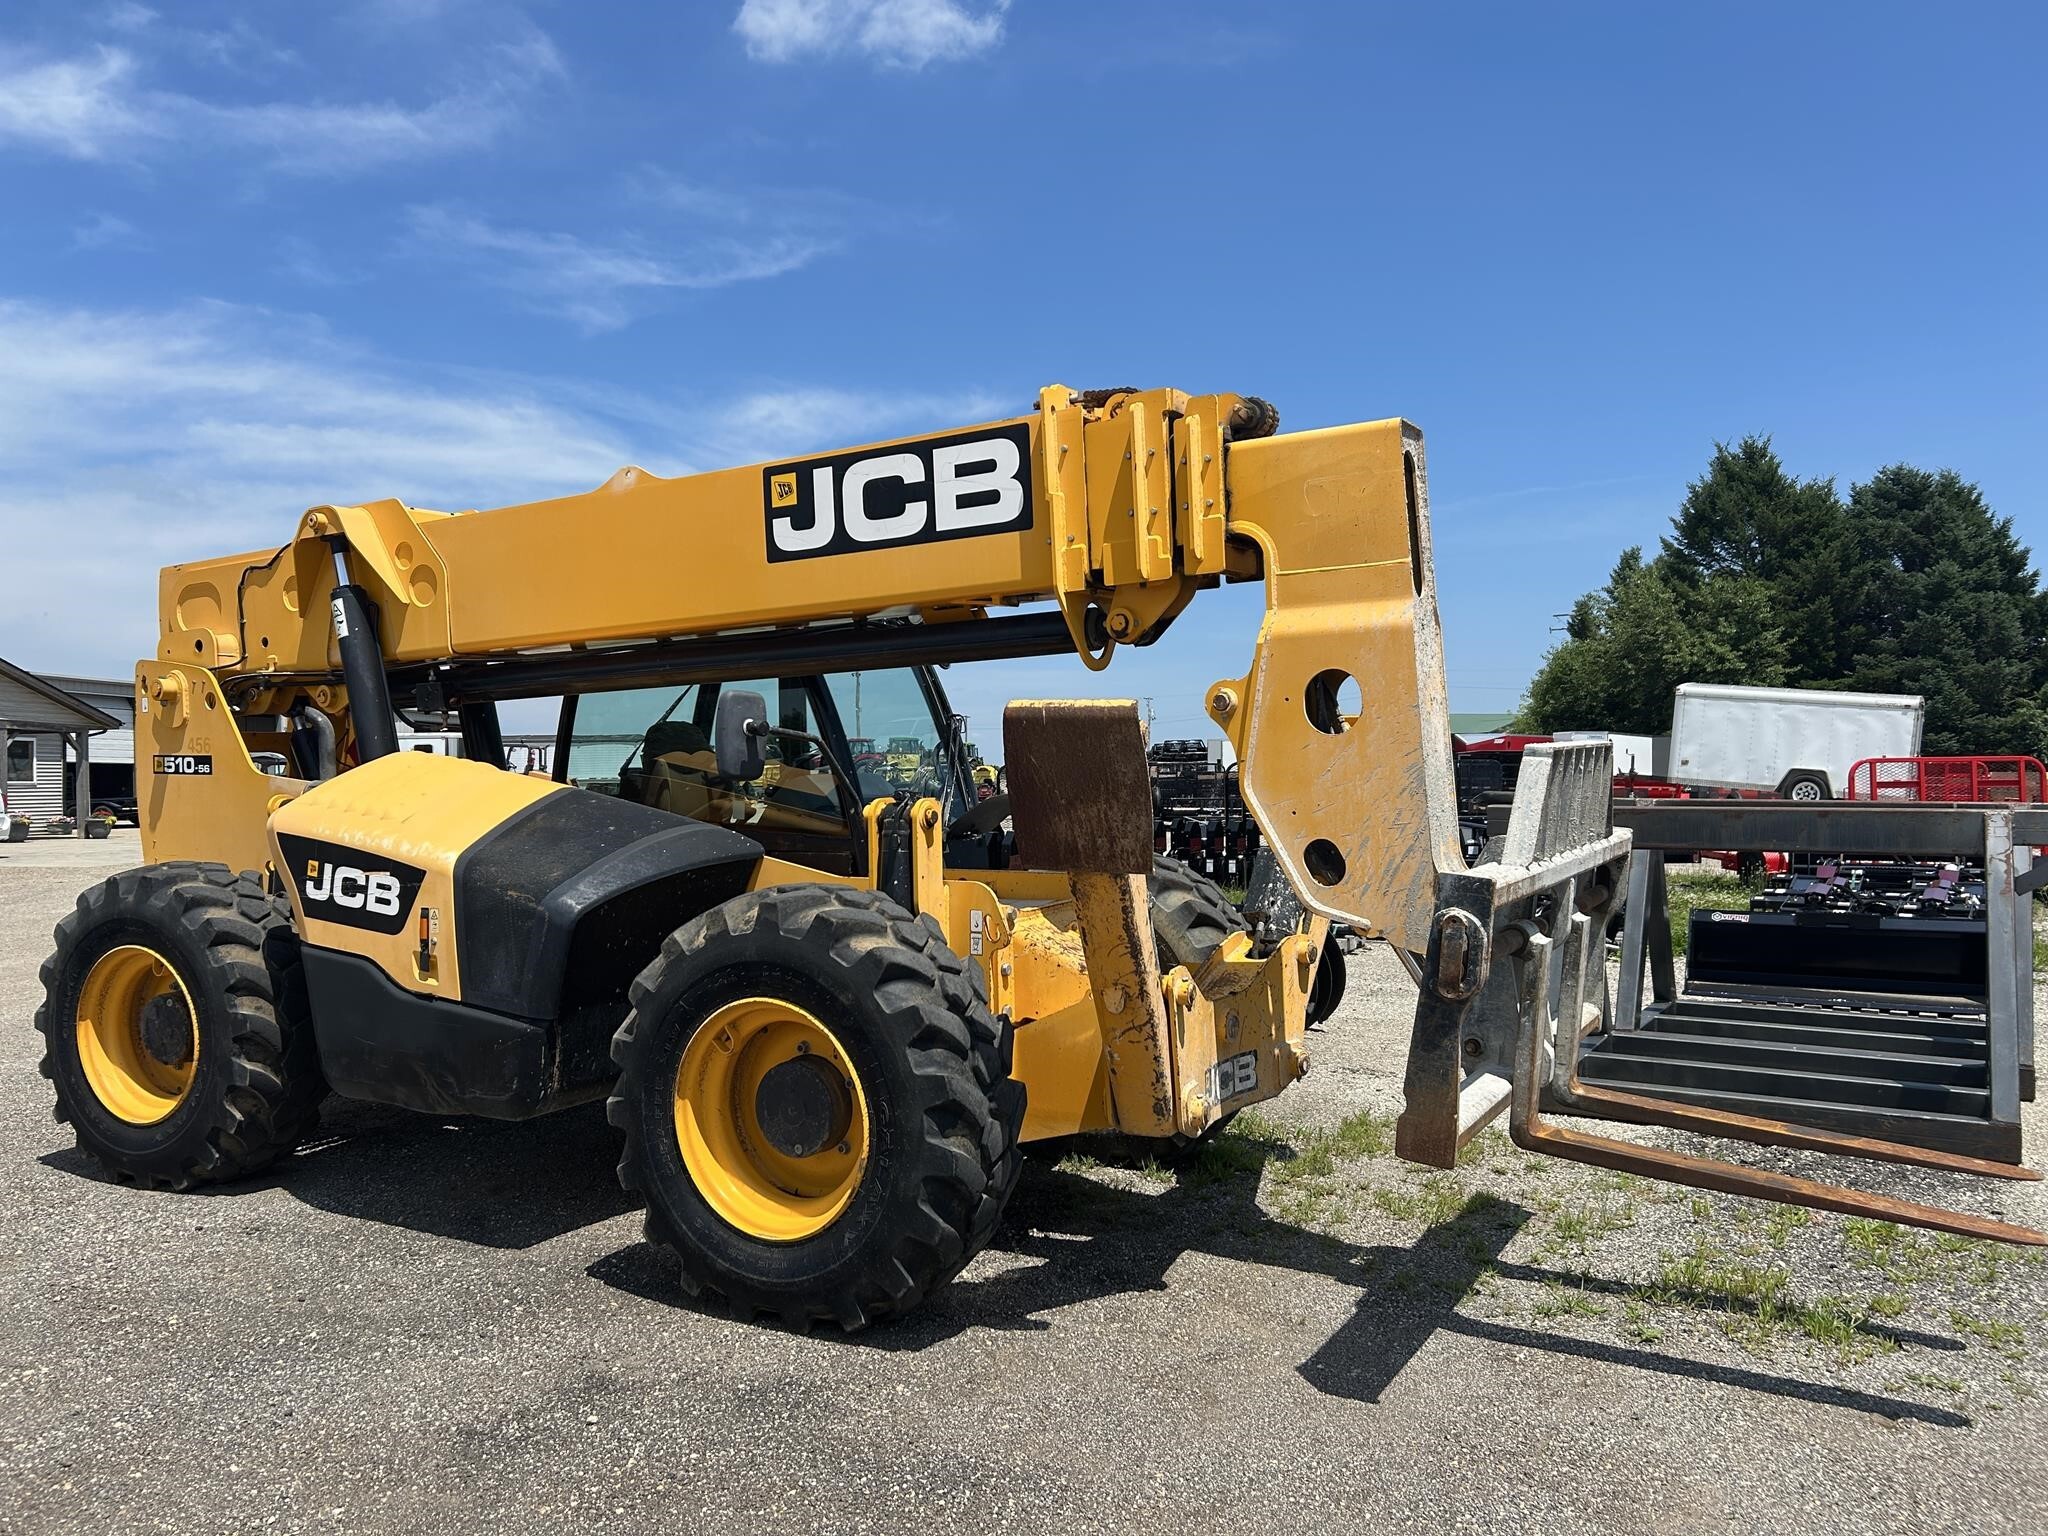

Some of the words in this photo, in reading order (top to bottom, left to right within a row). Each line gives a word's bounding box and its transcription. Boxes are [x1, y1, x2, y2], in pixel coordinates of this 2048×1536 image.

[773, 438, 1024, 551] JCB
[777, 481, 793, 499] JCB
[188, 737, 211, 753] 456
[306, 862, 400, 916] JCB
